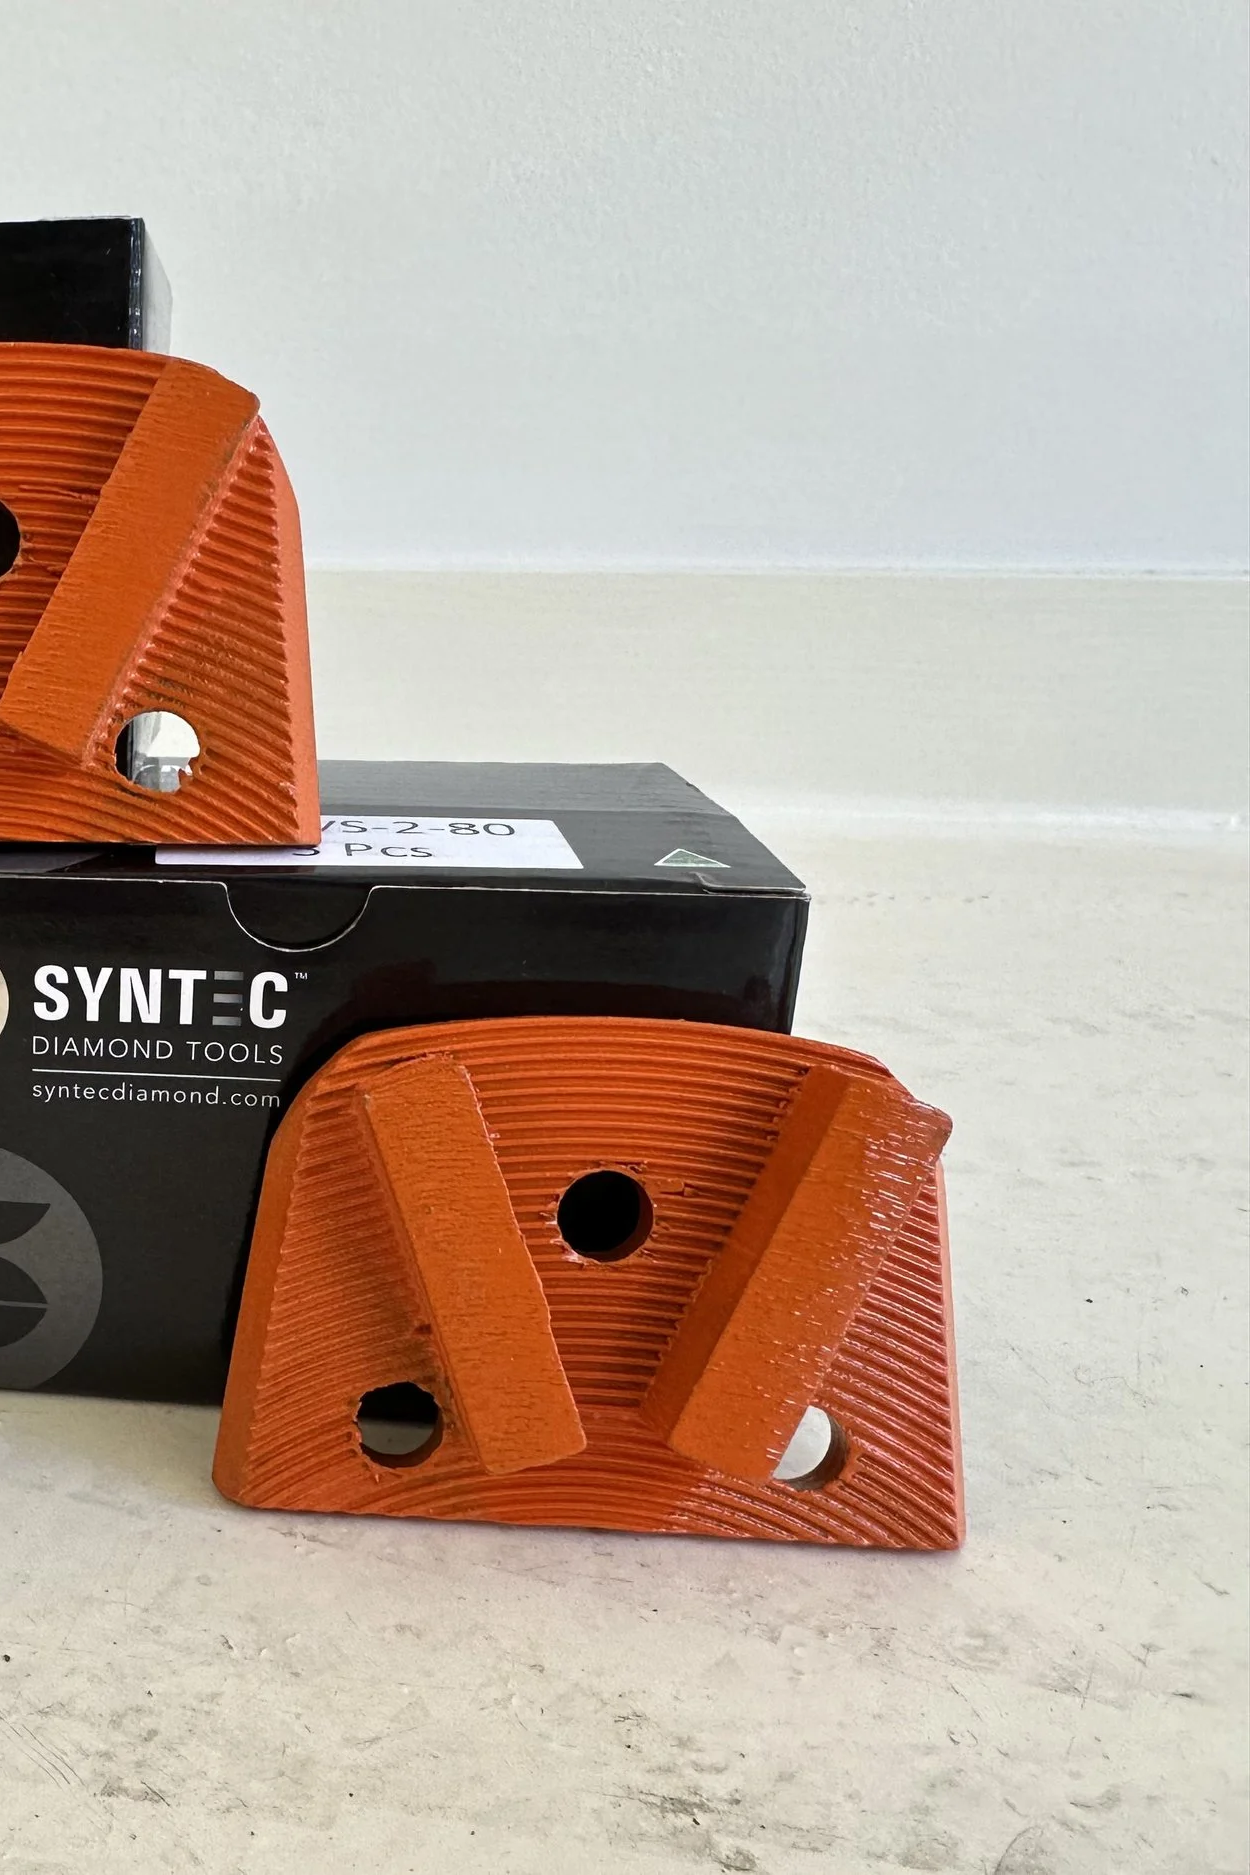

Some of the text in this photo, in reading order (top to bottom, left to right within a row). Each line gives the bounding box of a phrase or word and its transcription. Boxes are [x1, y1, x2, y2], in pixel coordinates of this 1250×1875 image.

[33, 964, 289, 1030] SYNTEC
[32, 1035, 283, 1065] DIAMOND TOOLS
[32, 1082, 281, 1108] syntecdiamond.com
